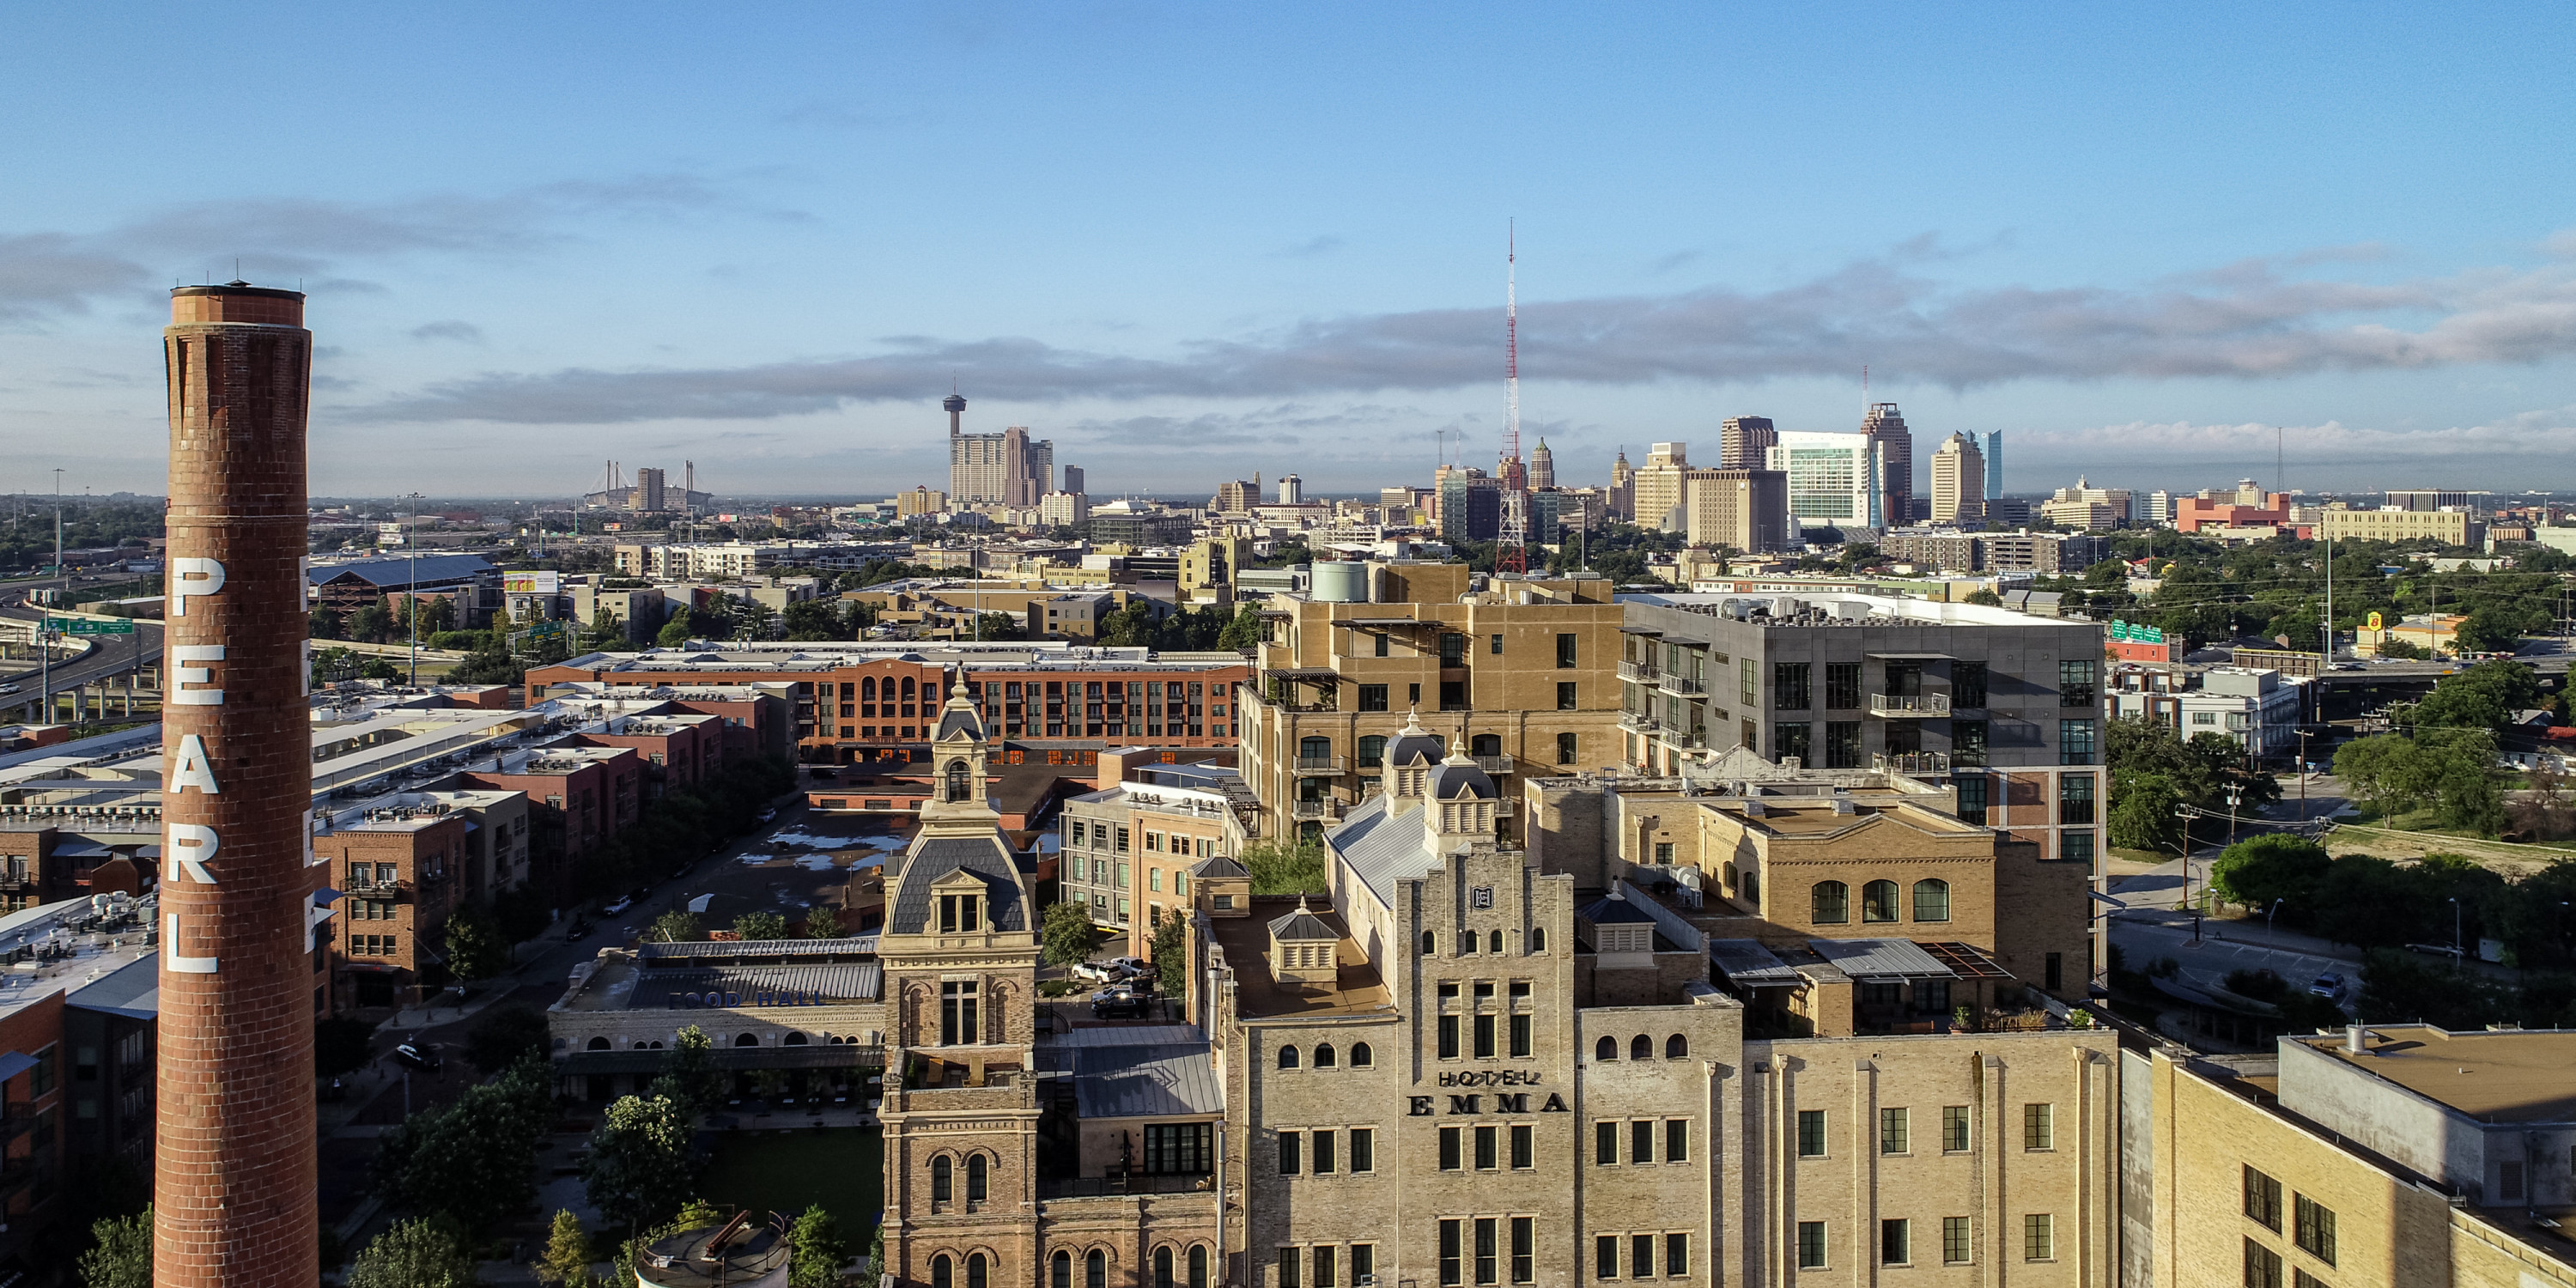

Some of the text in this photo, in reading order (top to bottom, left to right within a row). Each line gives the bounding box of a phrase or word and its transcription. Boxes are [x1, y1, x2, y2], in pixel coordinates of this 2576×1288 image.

[167, 557, 226, 974] PEARL
[669, 989, 826, 1010] FOOD HALL
[1439, 1070, 1537, 1087] HOTEL
[1406, 1092, 1572, 1116] EMMA
